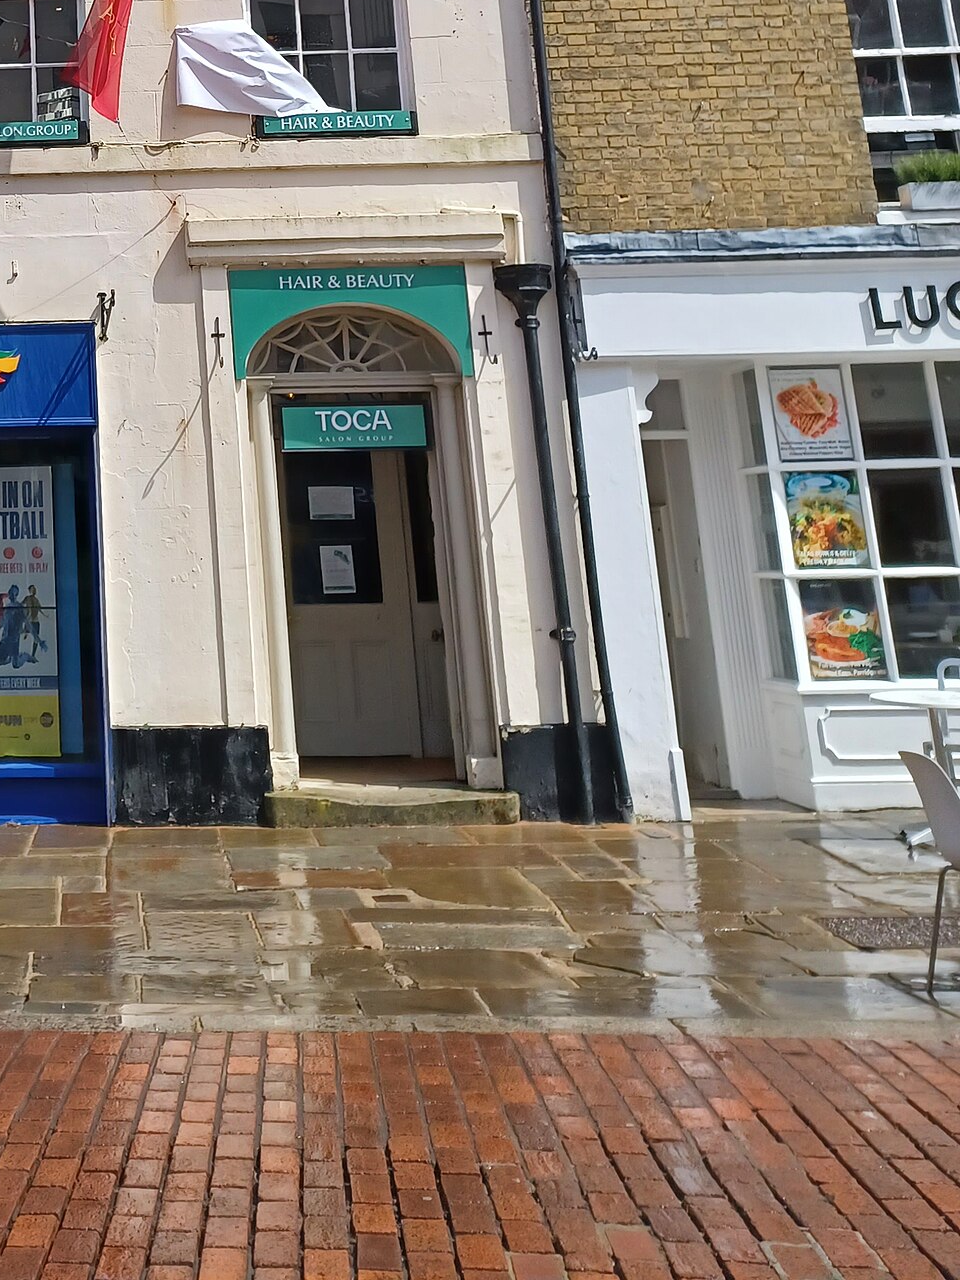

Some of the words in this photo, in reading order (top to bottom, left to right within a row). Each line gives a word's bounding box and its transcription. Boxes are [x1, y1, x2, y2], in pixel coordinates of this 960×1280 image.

[280, 116, 318, 130] HAIR
[321, 116, 333, 129] &
[336, 114, 395, 128] BEAUTY
[279, 275, 323, 290] HAIR
[327, 275, 341, 289] &
[345, 274, 415, 288] BEAUTY
[314, 409, 393, 432] TOCA
[318, 435, 352, 443] SALON
[2, 481, 19, 508] IN
[21, 480, 44, 508] ON
